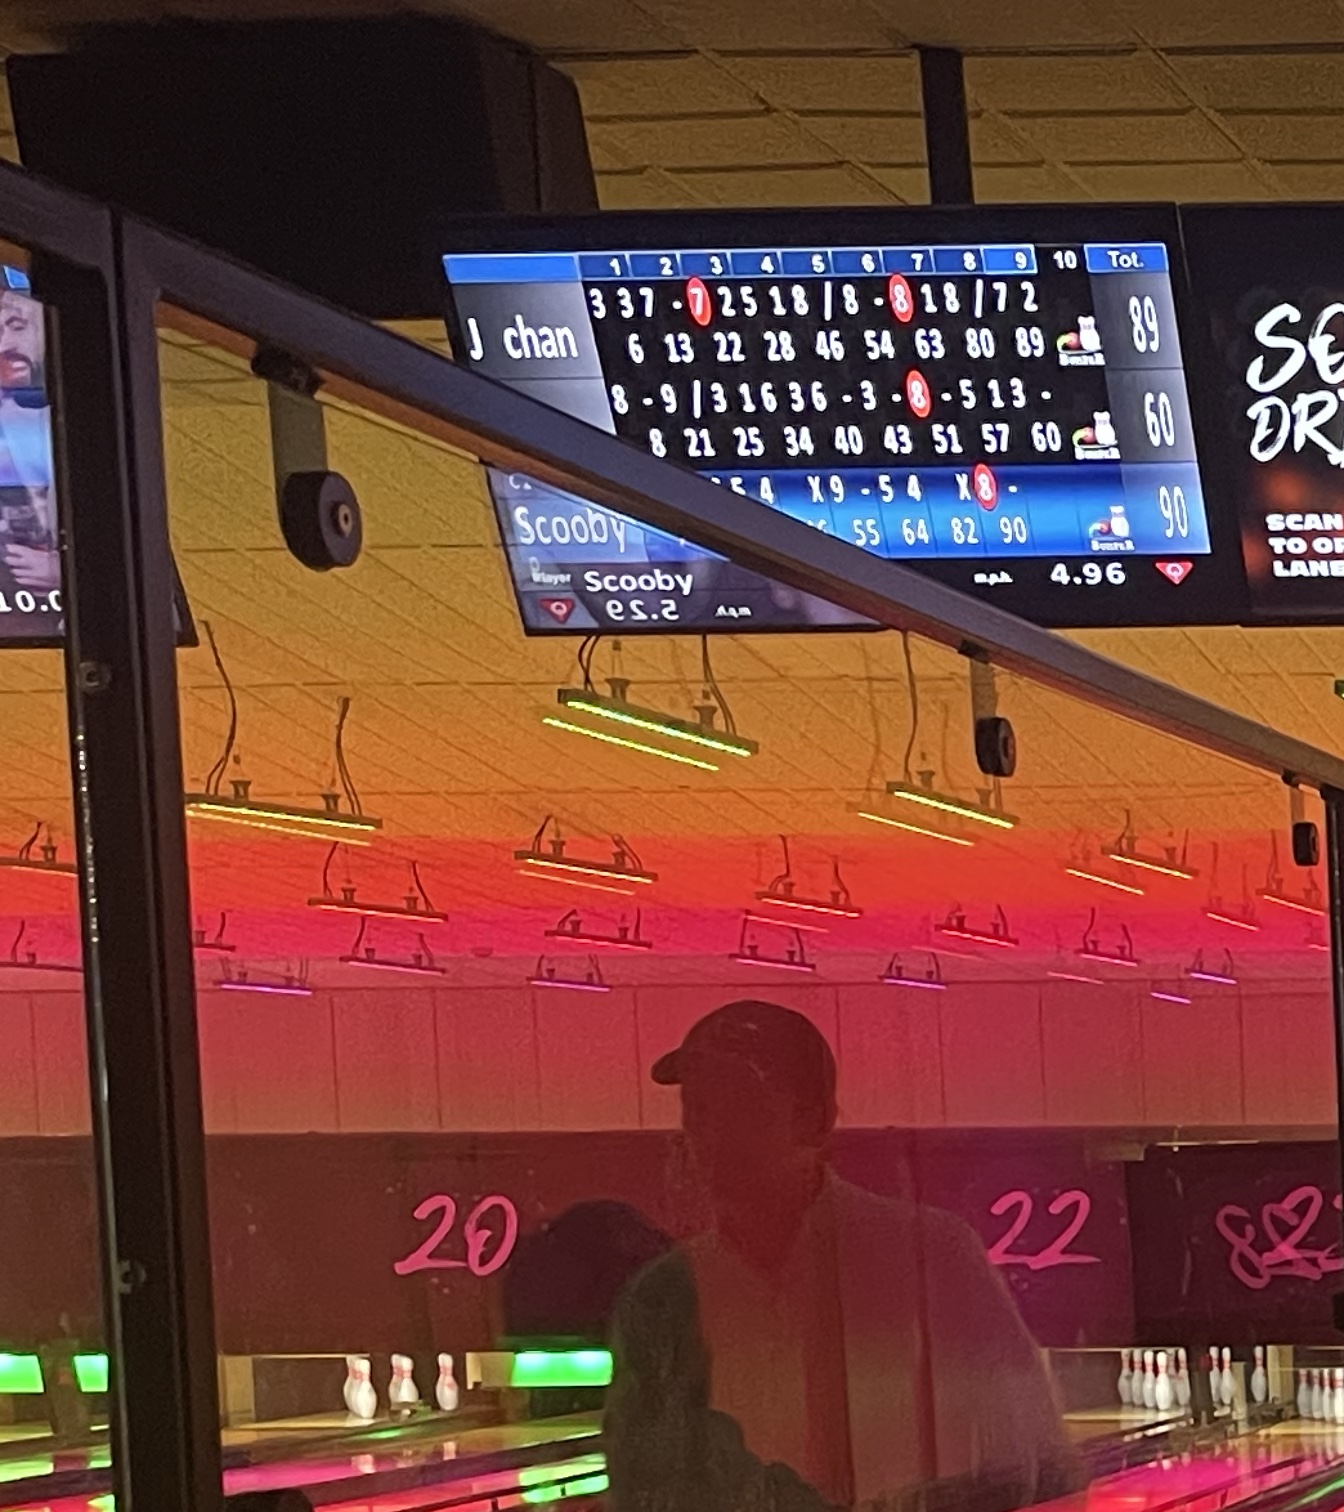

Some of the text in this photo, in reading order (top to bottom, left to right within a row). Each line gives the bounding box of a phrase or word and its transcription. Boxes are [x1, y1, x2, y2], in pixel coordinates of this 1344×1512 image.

[609, 250, 1145, 276] 1 2 3 4 5 6 7 8 9 10 Tot.
[466, 314, 579, 361] J chan
[627, 295, 1160, 364] 6 13 22 28 46 54 63 80 89 89
[649, 391, 1175, 458] 8 21 25 34 40 43 51 57 60 60
[514, 486, 1188, 553] Scooby 55 64 82 90 90
[1265, 513, 1343, 531] SCAN
[1268, 537, 1307, 554] TO
[583, 569, 693, 596] Scooby
[1049, 562, 1126, 586] 4.96
[394, 1194, 518, 1276] 20
[987, 1190, 1102, 1270] 22
